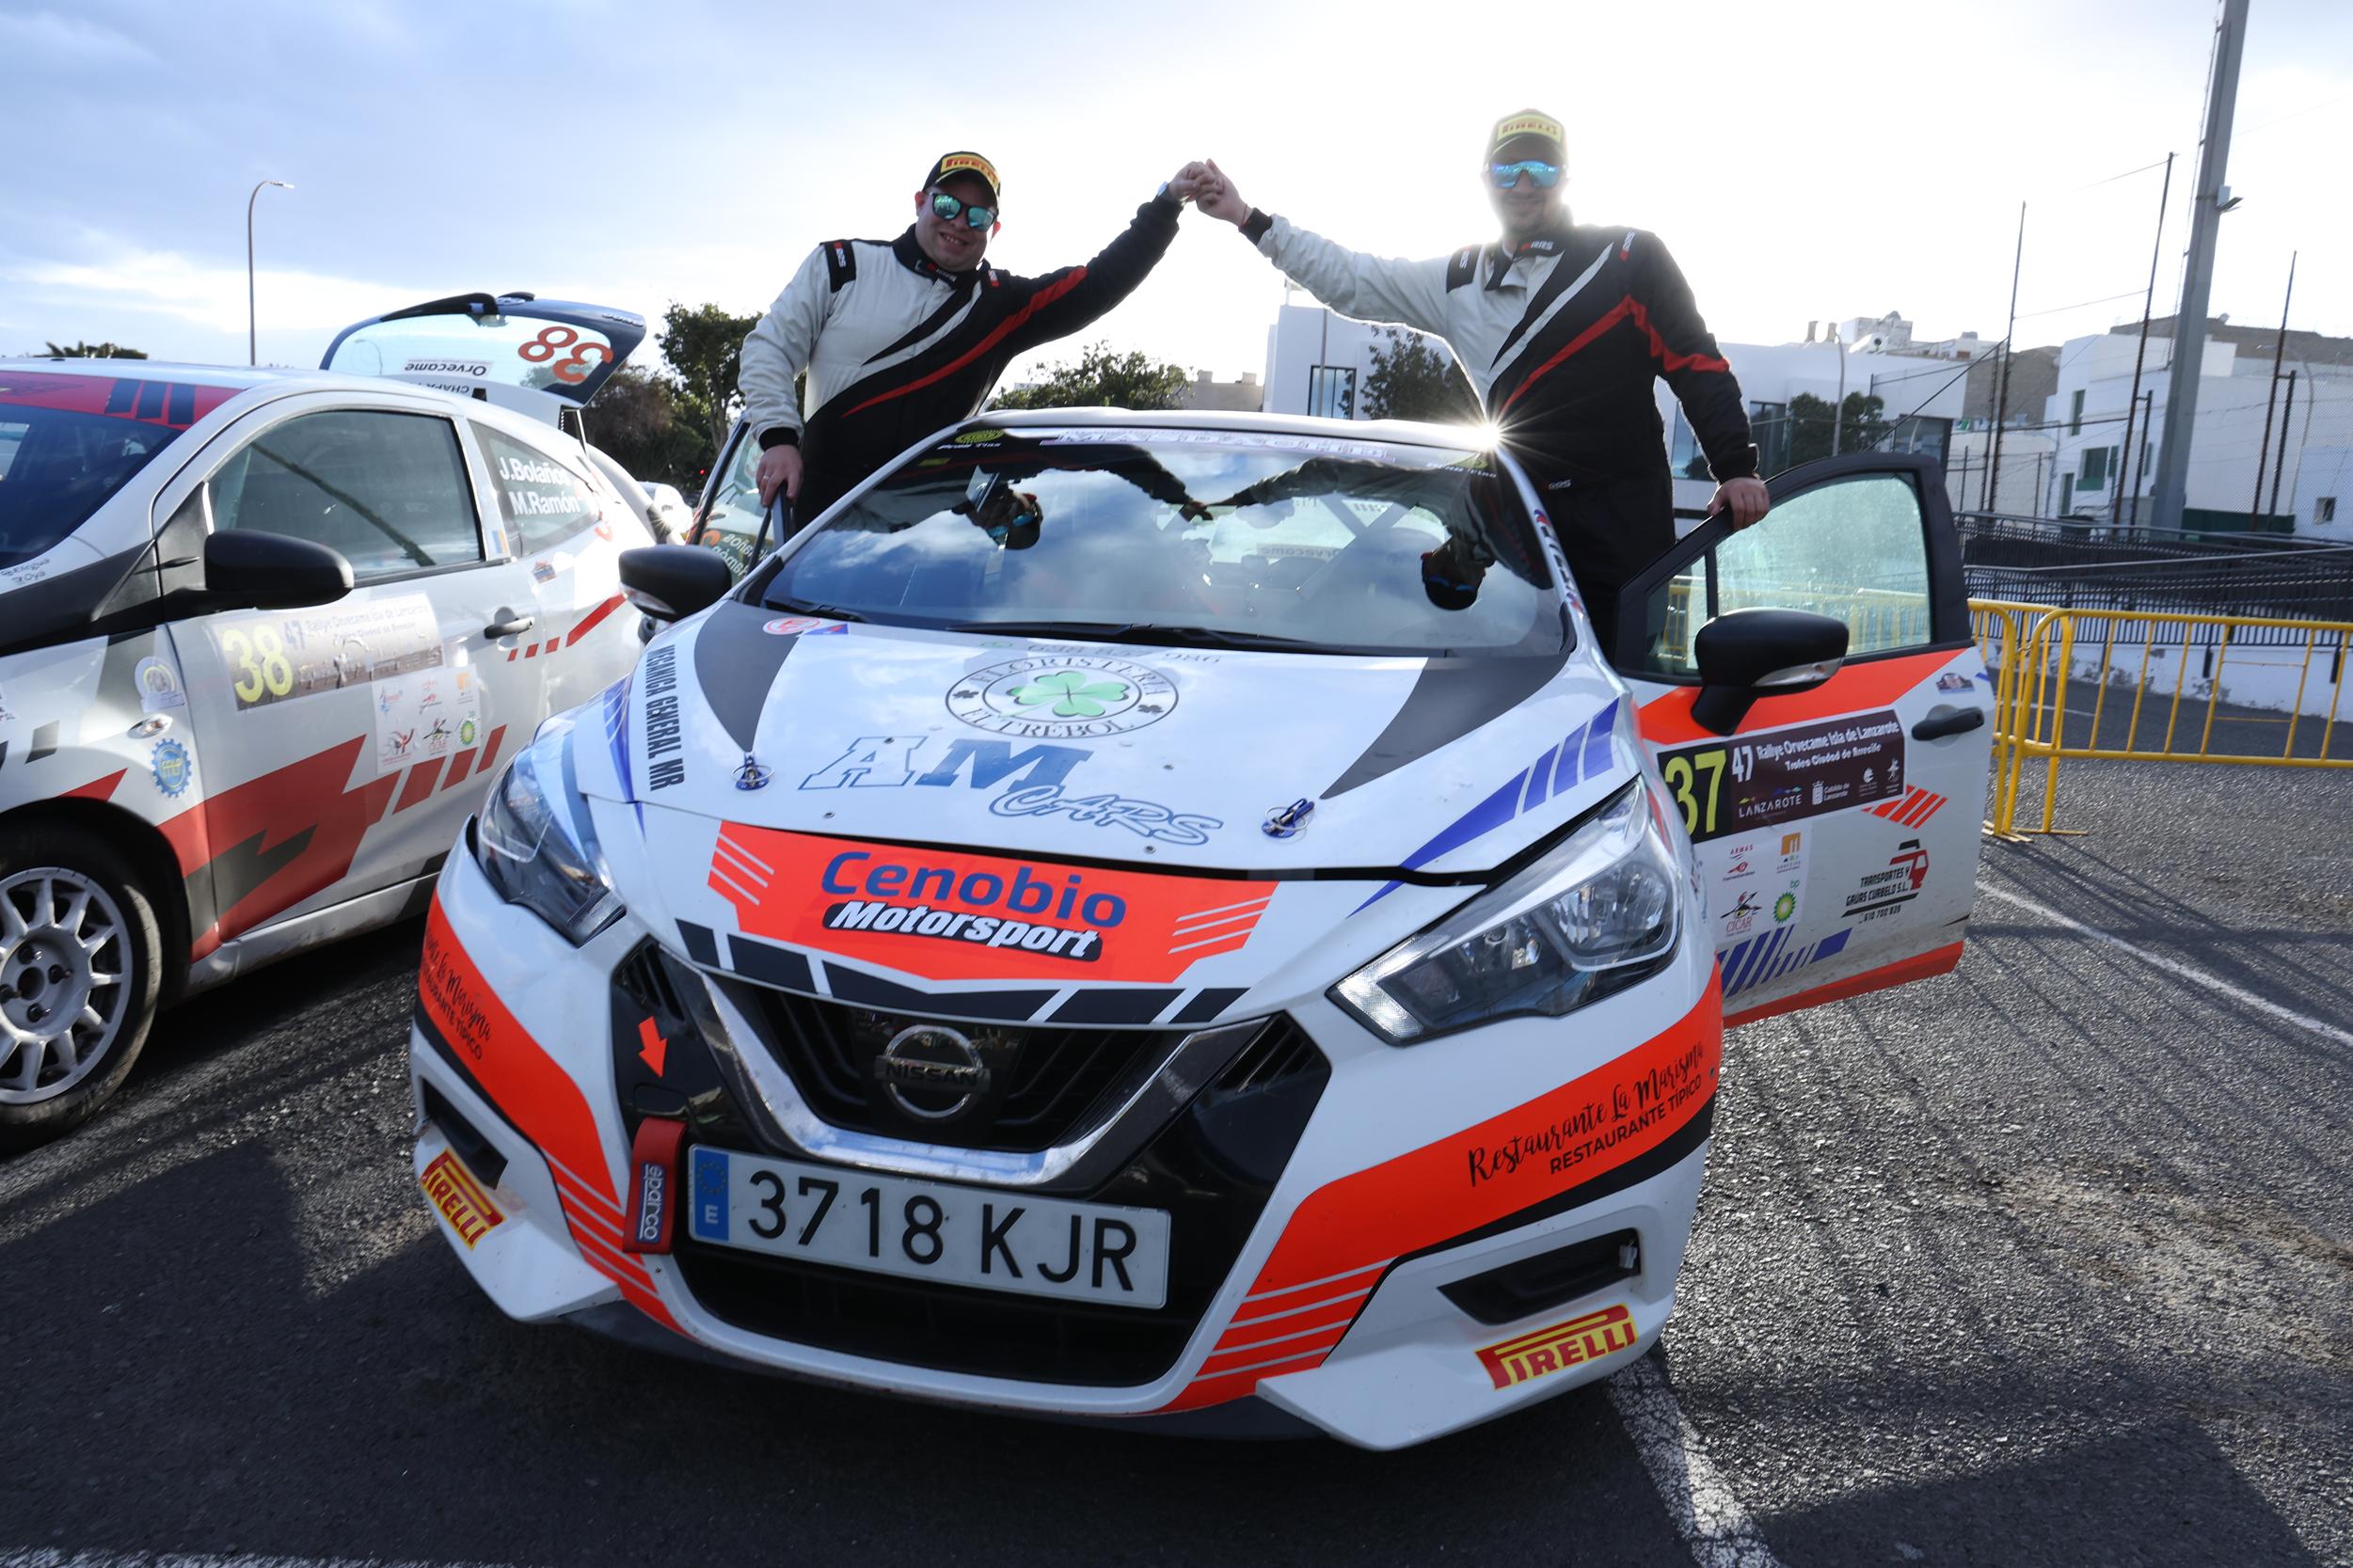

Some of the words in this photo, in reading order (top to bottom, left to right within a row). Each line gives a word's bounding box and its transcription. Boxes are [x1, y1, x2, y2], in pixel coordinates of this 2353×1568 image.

[404, 362, 487, 376] Orvecame
[517, 325, 614, 383] 38
[499, 456, 571, 486] J.Bolaños
[508, 490, 581, 515] M.Ramón
[222, 625, 294, 703] 38
[645, 643, 677, 698] MECANICA
[645, 694, 682, 760] GENERAL
[961, 707, 993, 729] EL
[649, 757, 685, 792] MR
[798, 736, 1095, 798] AM
[1731, 745, 1754, 783] 47
[1756, 742, 1785, 762] Rallye
[1783, 736, 1830, 754] Orvecame
[1829, 730, 1846, 746] Isla
[1845, 728, 1858, 743] de
[1856, 721, 1900, 740] Lanzarote
[1785, 759, 1811, 771] Trofeo
[1811, 751, 1840, 766] Ciudad
[1841, 749, 1852, 759] de
[988, 784, 1225, 846] CARS
[1664, 750, 1726, 837] 37
[1739, 794, 1803, 818] LANZAROTE
[821, 851, 1127, 928] Cenobio
[1790, 879, 1801, 890] bp
[1860, 866, 1904, 888] TRANSPORTES
[828, 900, 1101, 958] Motorsport
[1726, 917, 1753, 934] CICAR
[885, 1059, 979, 1086] NISSAN
[1468, 1101, 1608, 1187] Restaurante
[1612, 1084, 1631, 1122] La
[1632, 1041, 1704, 1110] Marisma
[1550, 1102, 1666, 1174] RESTAURANTE
[1668, 1074, 1702, 1113] TÍPICO
[640, 1164, 663, 1243] sparco
[748, 1169, 944, 1265] 3718
[979, 1203, 1137, 1292] KJR
[1474, 1304, 1636, 1390] PIRELLI
